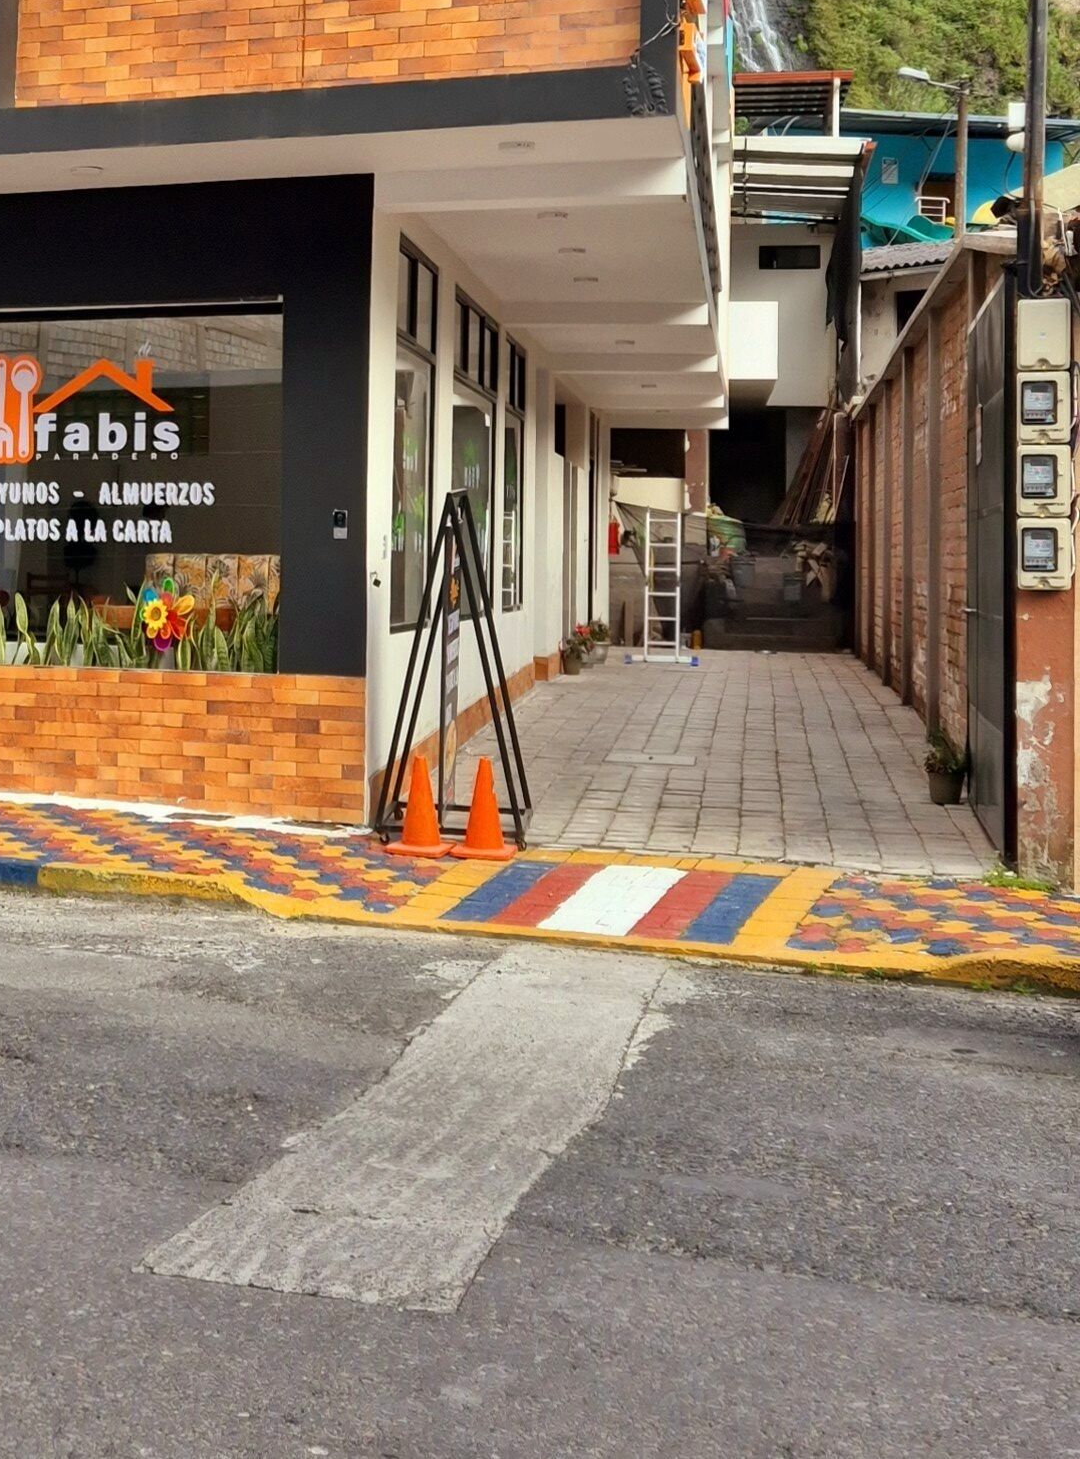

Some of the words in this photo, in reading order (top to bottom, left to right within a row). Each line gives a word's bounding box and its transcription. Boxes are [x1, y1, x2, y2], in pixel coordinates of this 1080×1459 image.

[33, 412, 181, 452] fabis
[35, 453, 179, 461] PARADERO
[98, 482, 215, 506] ALMUERZOS
[65, 519, 79, 542] A
[84, 519, 107, 543] LA
[112, 519, 173, 543] CARTA
